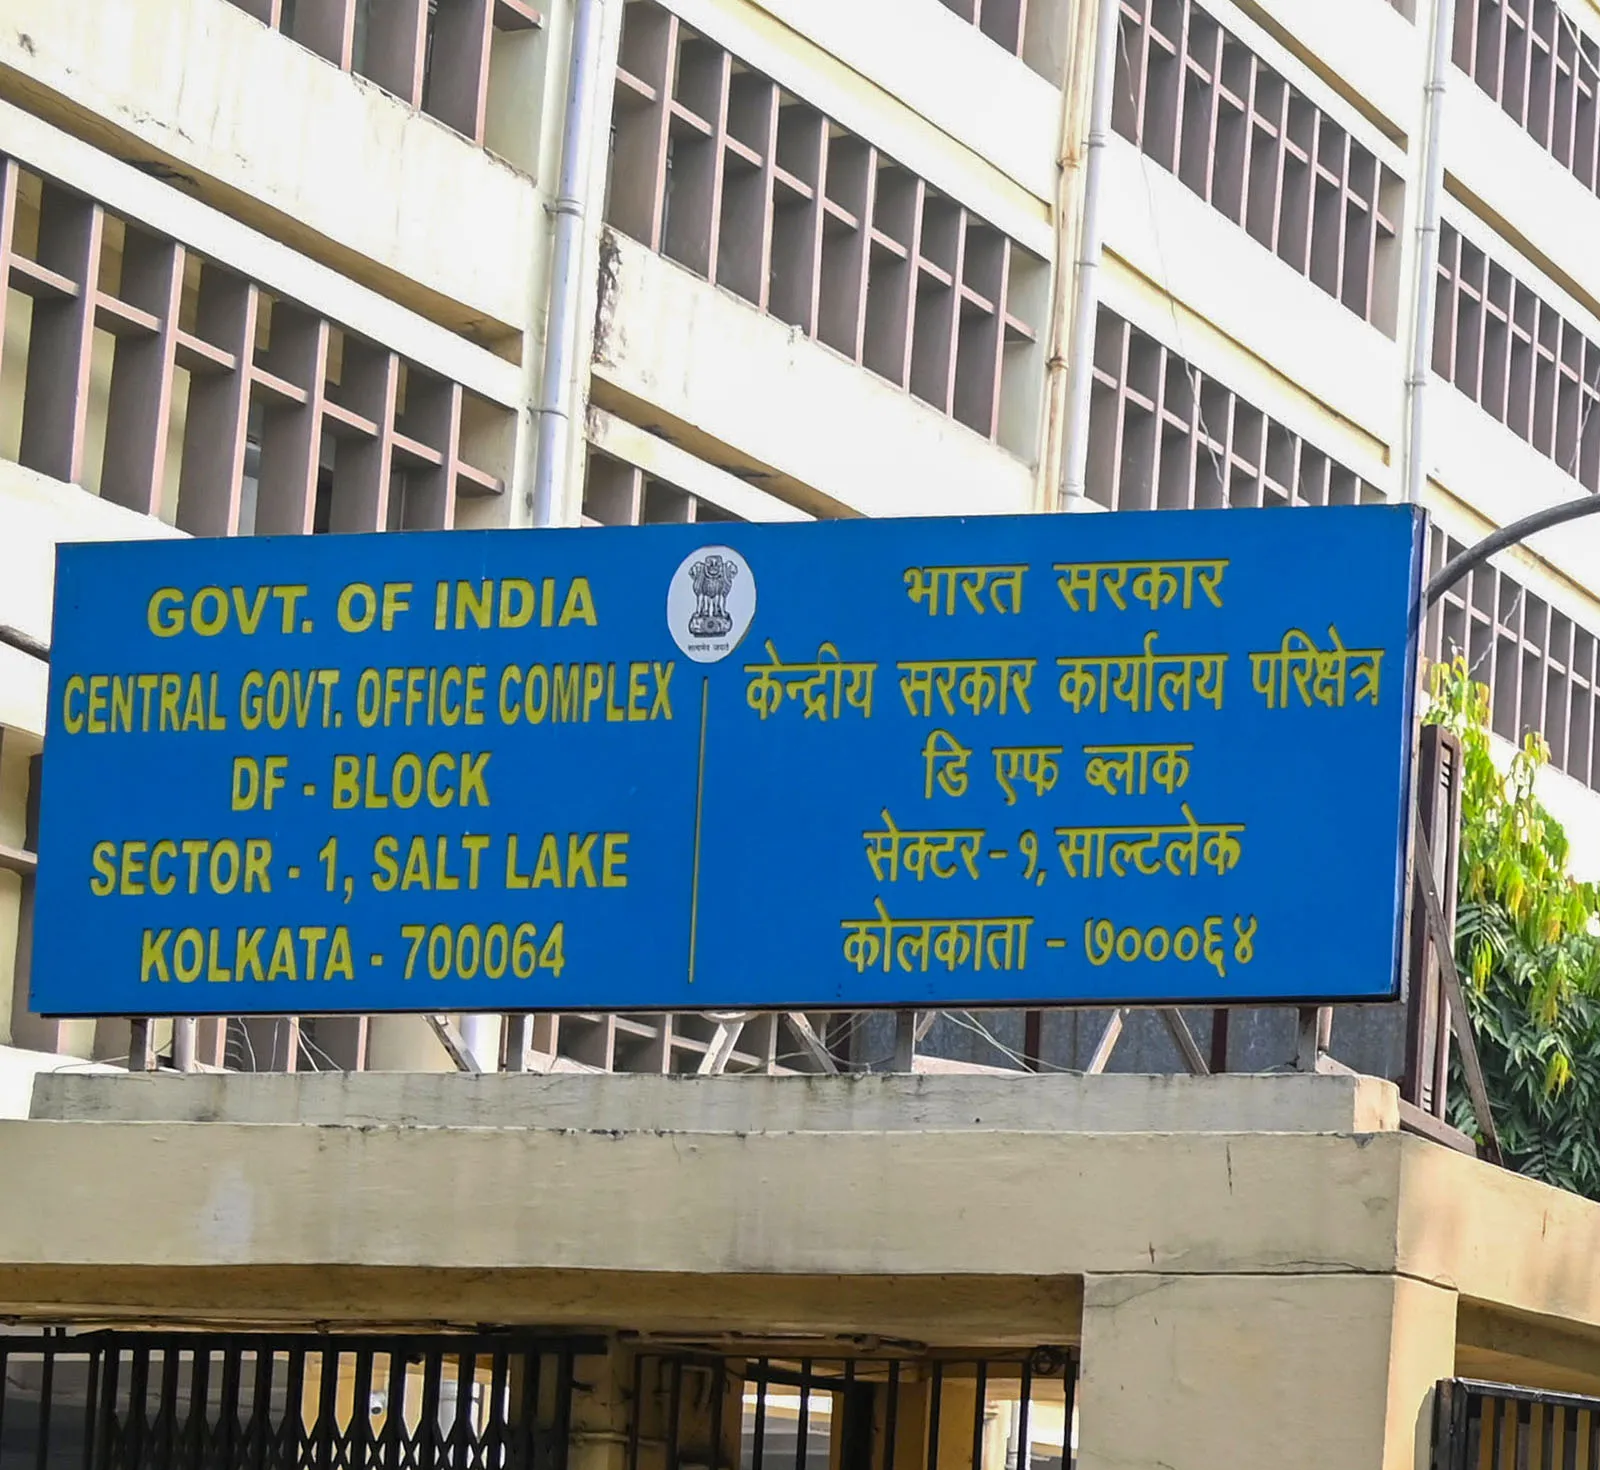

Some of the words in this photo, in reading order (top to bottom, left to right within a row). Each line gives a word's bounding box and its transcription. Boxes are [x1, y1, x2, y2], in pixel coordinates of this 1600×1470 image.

[148, 585, 313, 638] GOVT.
[338, 582, 413, 632] OF
[434, 577, 598, 630] INDIA
[903, 563, 1030, 616] भारत
[1053, 558, 1231, 612] सरकार
[63, 673, 227, 734] CENTRAL
[240, 669, 343, 731] GOVT.
[357, 666, 487, 727] OFFICE
[500, 661, 675, 724] COMPLEX
[744, 640, 878, 721] केन्द्रीय
[897, 658, 1037, 717] सरकार
[1056, 630, 1229, 713] कार्यालय
[1249, 625, 1385, 709] परिक्षेत्र
[231, 755, 289, 812] DF
[303, 784, 316, 796] -
[332, 752, 492, 810] BLOCK
[921, 729, 972, 800] डि
[992, 746, 1063, 806] एफ
[1083, 743, 1195, 796] ब्लाक
[90, 839, 273, 897] SECTOR
[288, 866, 301, 879] -
[319, 837, 354, 904] 1,
[372, 834, 491, 892] SALT
[505, 832, 630, 890] LAKE
[140, 926, 355, 984] KOLKATA
[370, 953, 383, 967] -
[401, 922, 566, 981] 700064
[841, 896, 1035, 973] कोलकाता
[1084, 914, 1259, 978] ७०००६४
